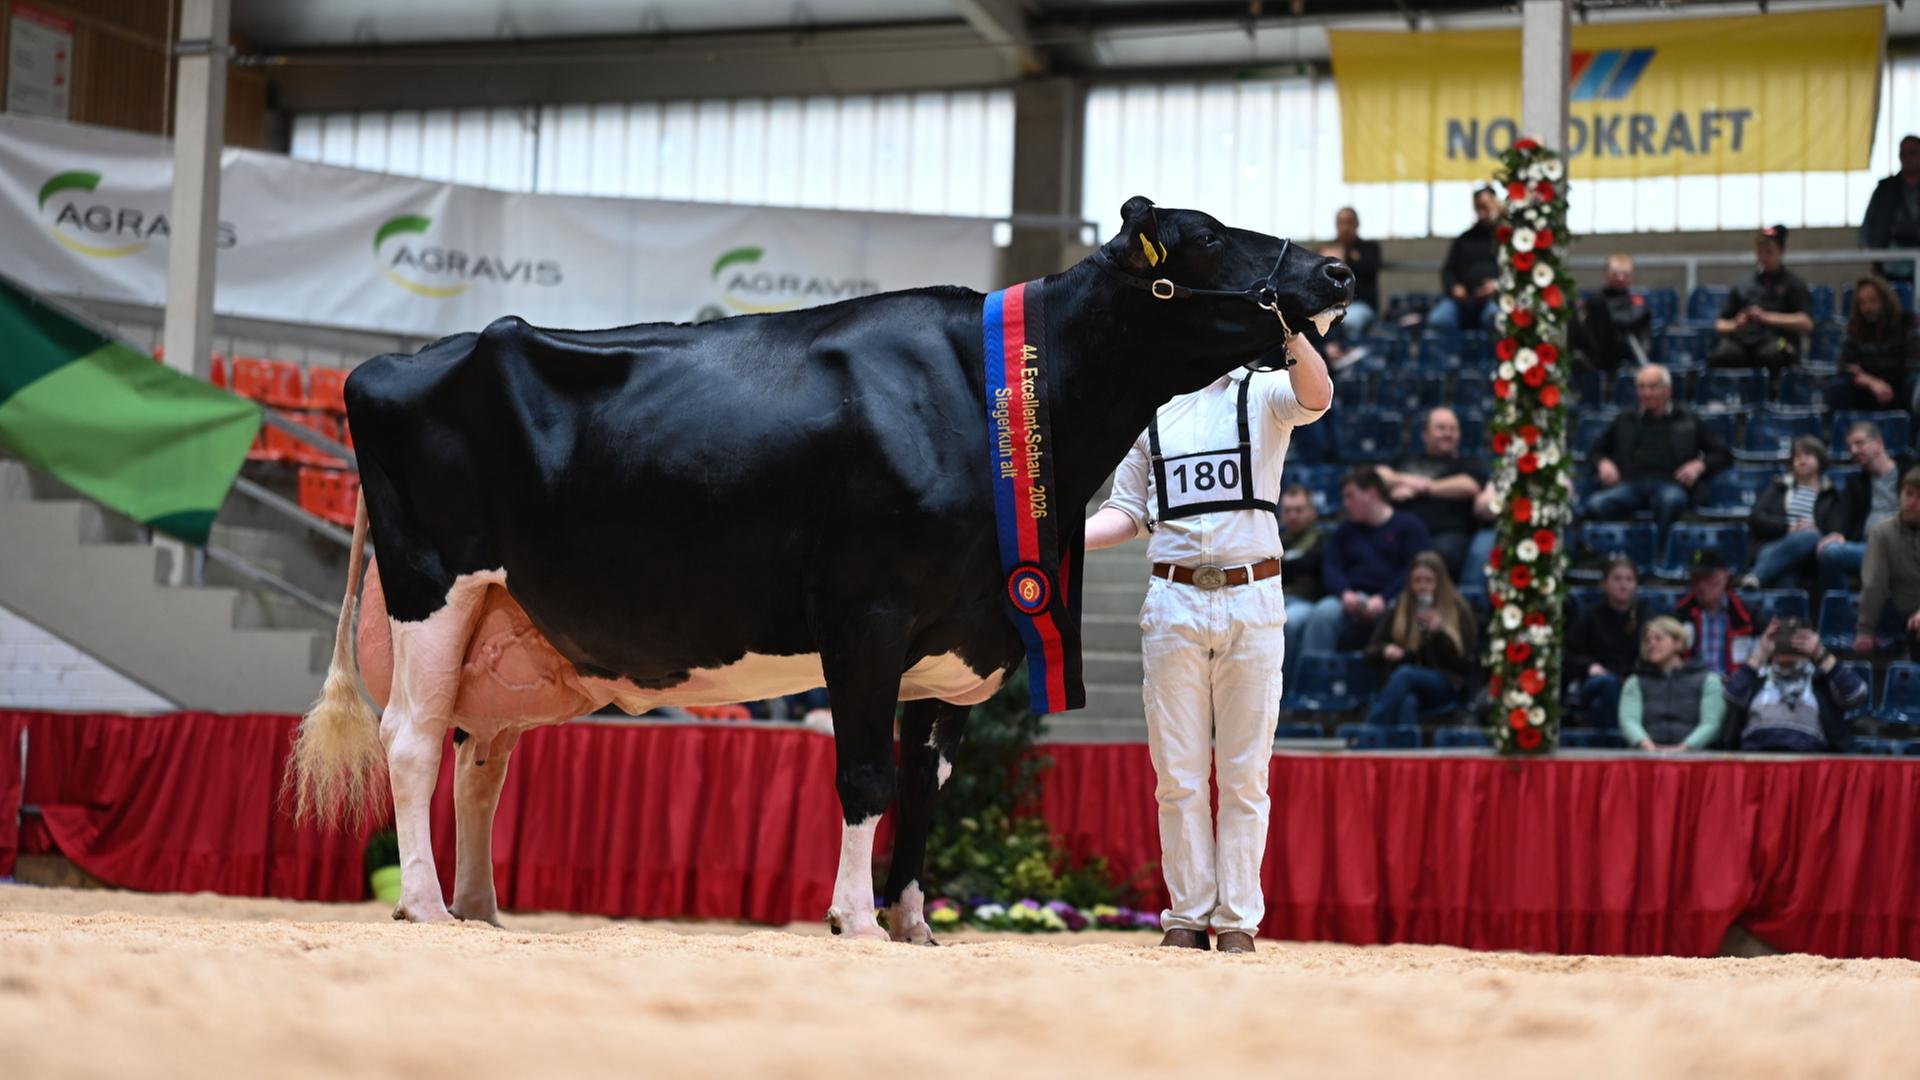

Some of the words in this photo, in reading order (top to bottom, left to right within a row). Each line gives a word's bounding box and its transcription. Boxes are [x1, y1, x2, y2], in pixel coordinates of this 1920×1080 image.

[1447, 109, 1752, 159] NODKRAFT
[56, 202, 237, 250] AGRAS
[391, 245, 563, 287] AGRAVIS
[728, 272, 880, 297] AGRAVIS
[1020, 344, 1037, 365] 44.
[992, 387, 1017, 457] Siegerkuh
[1020, 367, 1043, 478] Excellent-Schau
[1000, 461, 1019, 479] alt
[1173, 459, 1239, 494] 180
[1028, 485, 1048, 519] 2026
